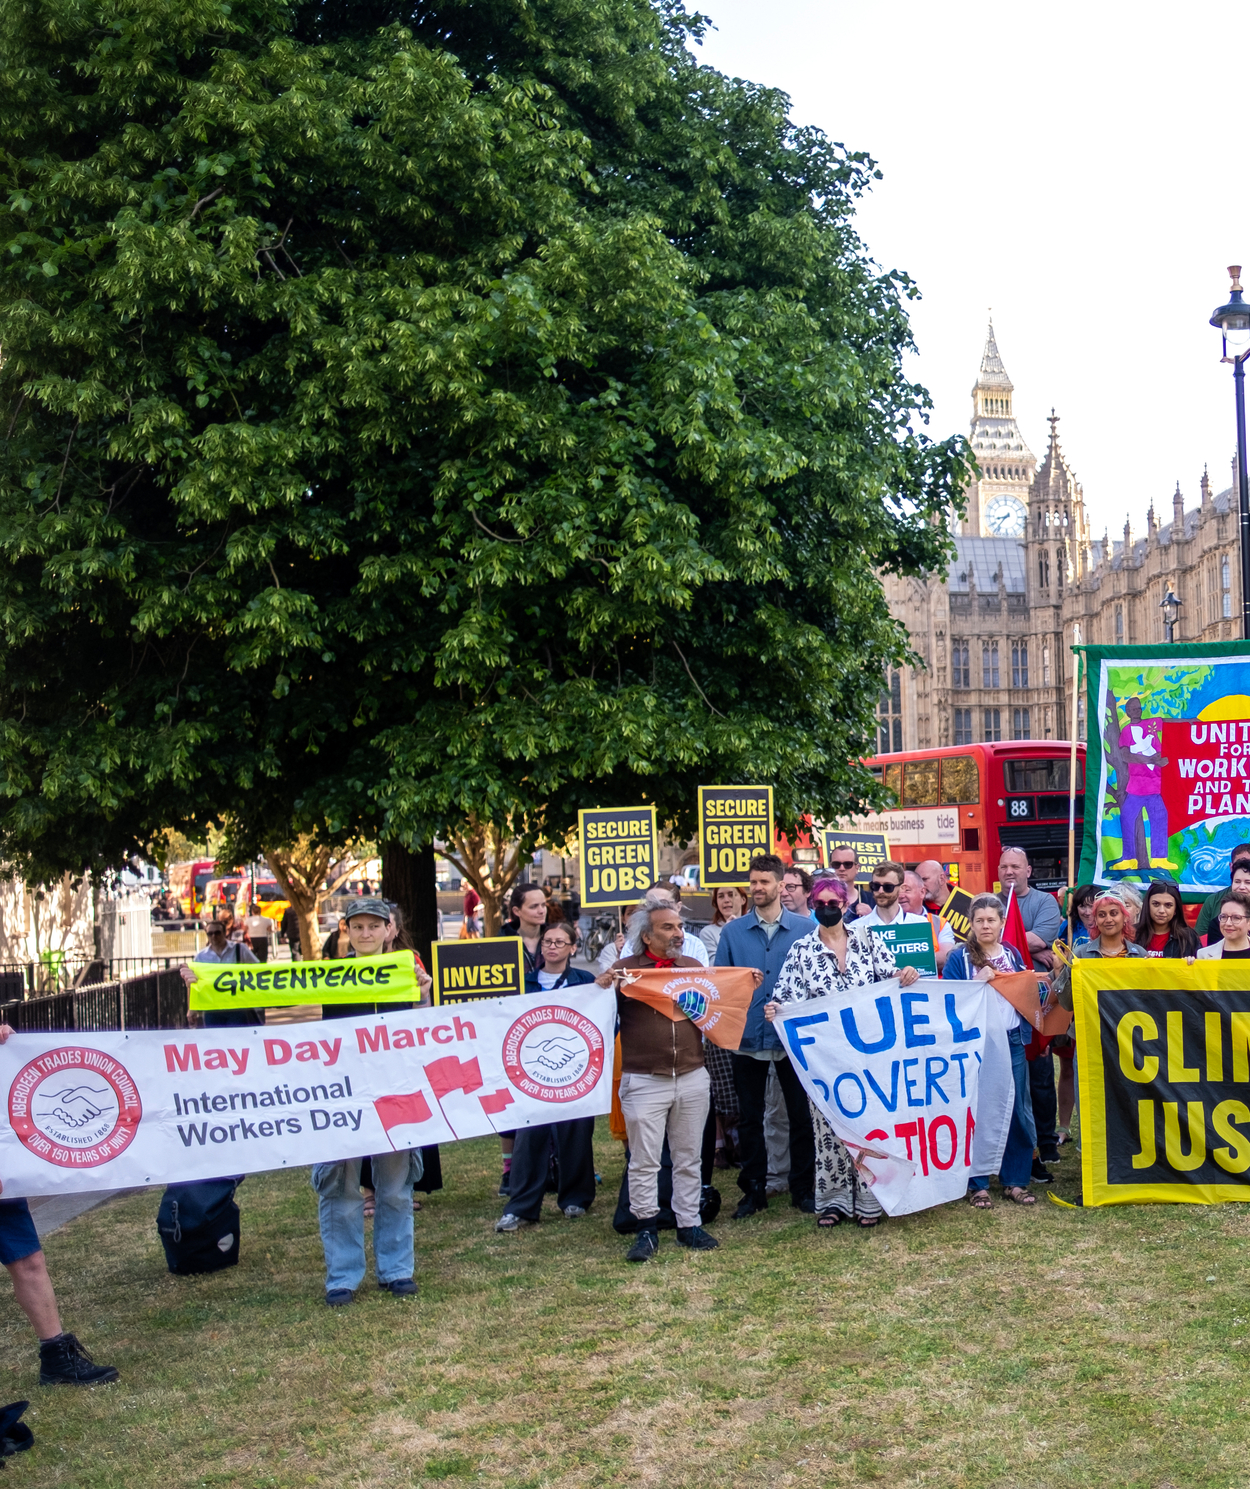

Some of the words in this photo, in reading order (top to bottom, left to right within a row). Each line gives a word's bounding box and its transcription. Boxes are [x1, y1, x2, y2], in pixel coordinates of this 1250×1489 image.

[1193, 780, 1232, 794] AND
[705, 799, 767, 817] SECURE
[1011, 800, 1028, 816] 88
[586, 819, 650, 839] SECURE
[890, 815, 925, 831] business
[936, 814, 955, 829] tide
[706, 825, 767, 844] GREEN
[587, 844, 650, 866] GREEN
[589, 866, 651, 893] JOBS
[213, 964, 398, 996] GREENPEACE
[443, 963, 515, 988] INVEST
[506, 1023, 527, 1066] ABERDEEN
[521, 1008, 552, 1028] TRADES
[554, 1008, 580, 1026] UNION
[577, 1020, 603, 1051] COUNCIL
[783, 992, 981, 1072] FUEL
[163, 1043, 250, 1076] May
[263, 1036, 343, 1067] Day
[354, 1015, 478, 1055] March
[12, 1066, 42, 1118] ABERDEEN
[37, 1050, 82, 1073] TRADES
[84, 1051, 116, 1075] UNION
[111, 1069, 139, 1110] COUNCIL
[520, 1079, 540, 1095] OVER
[540, 1088, 554, 1099] 150
[555, 1087, 578, 1099] YEARS
[576, 1083, 587, 1093] OF
[583, 1065, 600, 1086] UNITY
[532, 1070, 572, 1084] ESTABLISHED
[174, 1075, 354, 1116] International
[44, 1125, 93, 1144] ESTABLISHED
[177, 1119, 302, 1149] Workers
[310, 1108, 363, 1133] Day
[27, 1133, 52, 1155] OVER
[51, 1147, 69, 1162] 150
[70, 1150, 100, 1163] YEARS
[98, 1143, 112, 1157] OF
[109, 1126, 132, 1149] UNITY
